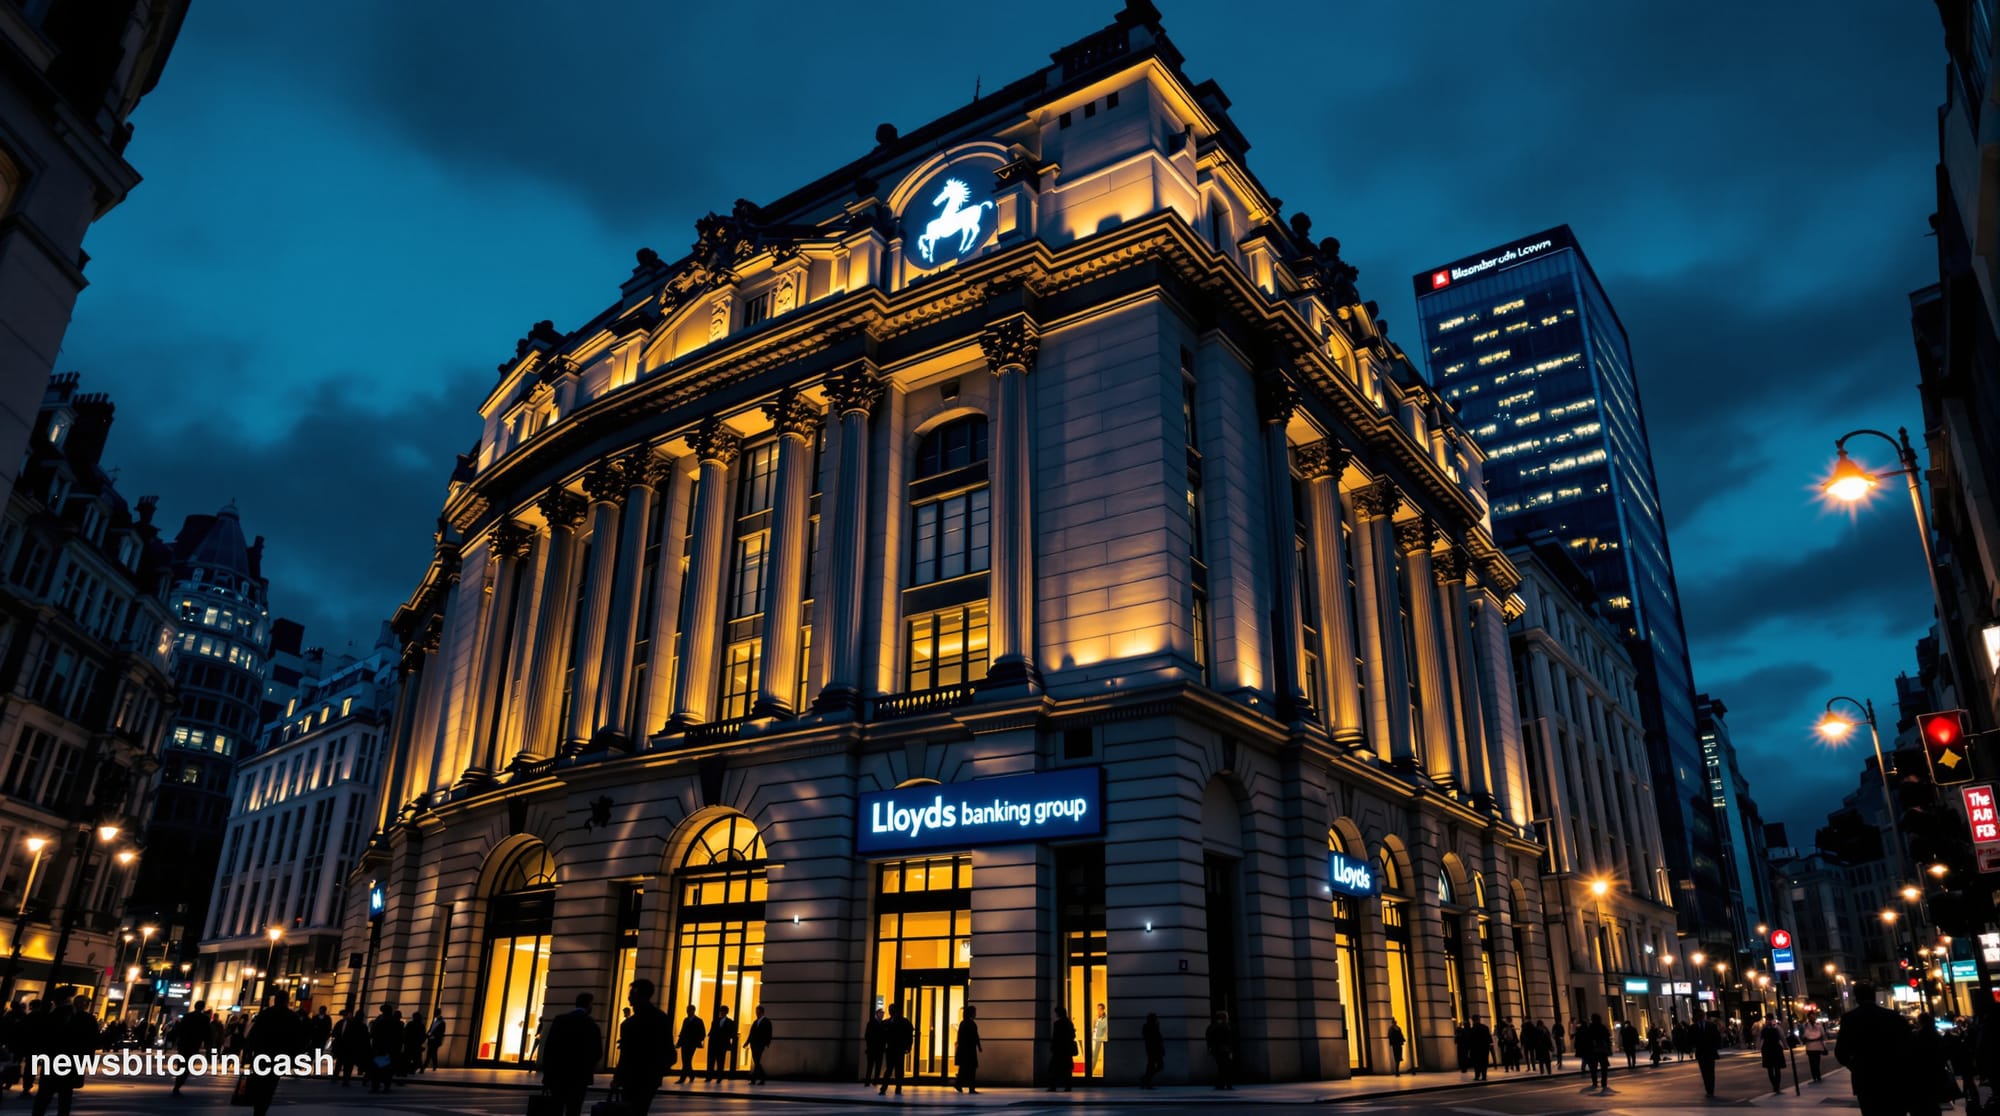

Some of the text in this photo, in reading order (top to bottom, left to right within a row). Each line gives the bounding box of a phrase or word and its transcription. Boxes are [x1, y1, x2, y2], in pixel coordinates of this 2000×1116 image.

[872, 796, 1087, 837] Lloyds banking group
[1968, 792, 1990, 807] The
[1334, 855, 1370, 890] Lloyds
